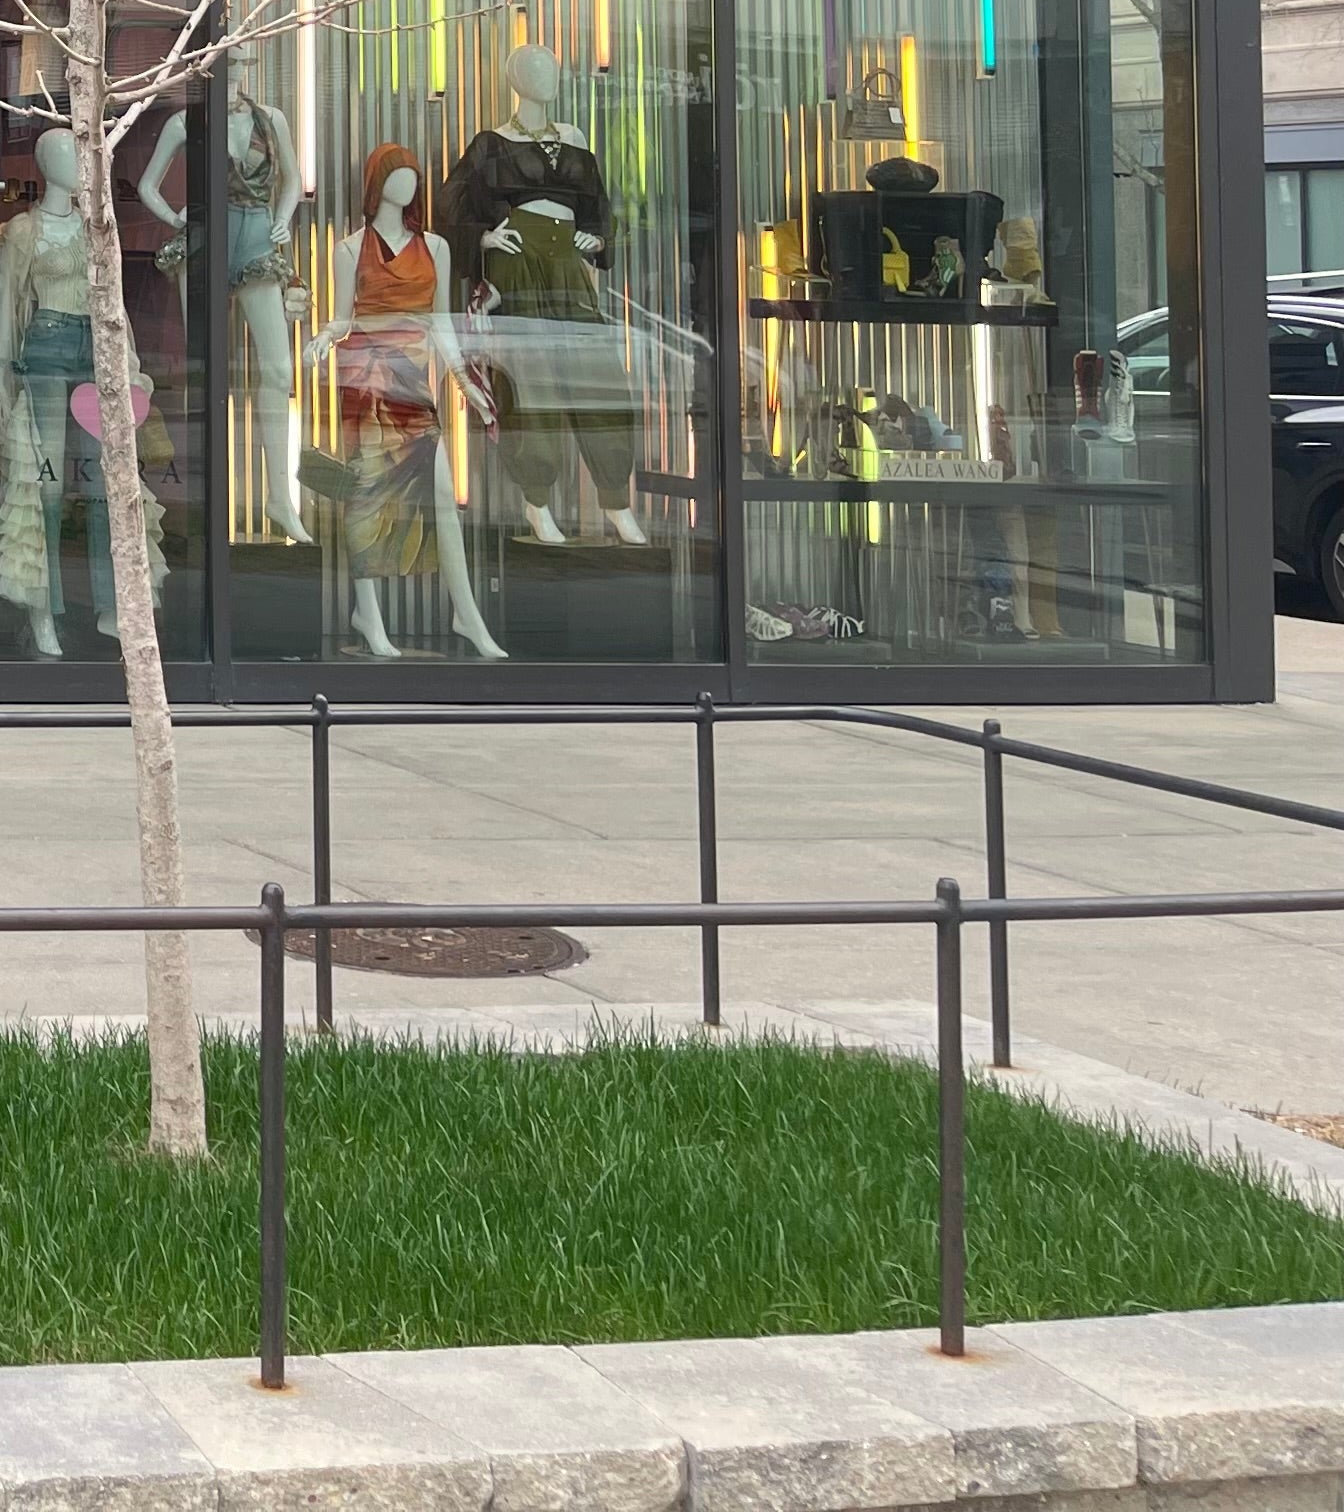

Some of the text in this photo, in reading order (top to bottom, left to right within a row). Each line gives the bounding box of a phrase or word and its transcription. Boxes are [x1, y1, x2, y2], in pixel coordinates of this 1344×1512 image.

[36, 457, 183, 485] AKA
[883, 462, 999, 480] AZALEA WANG
